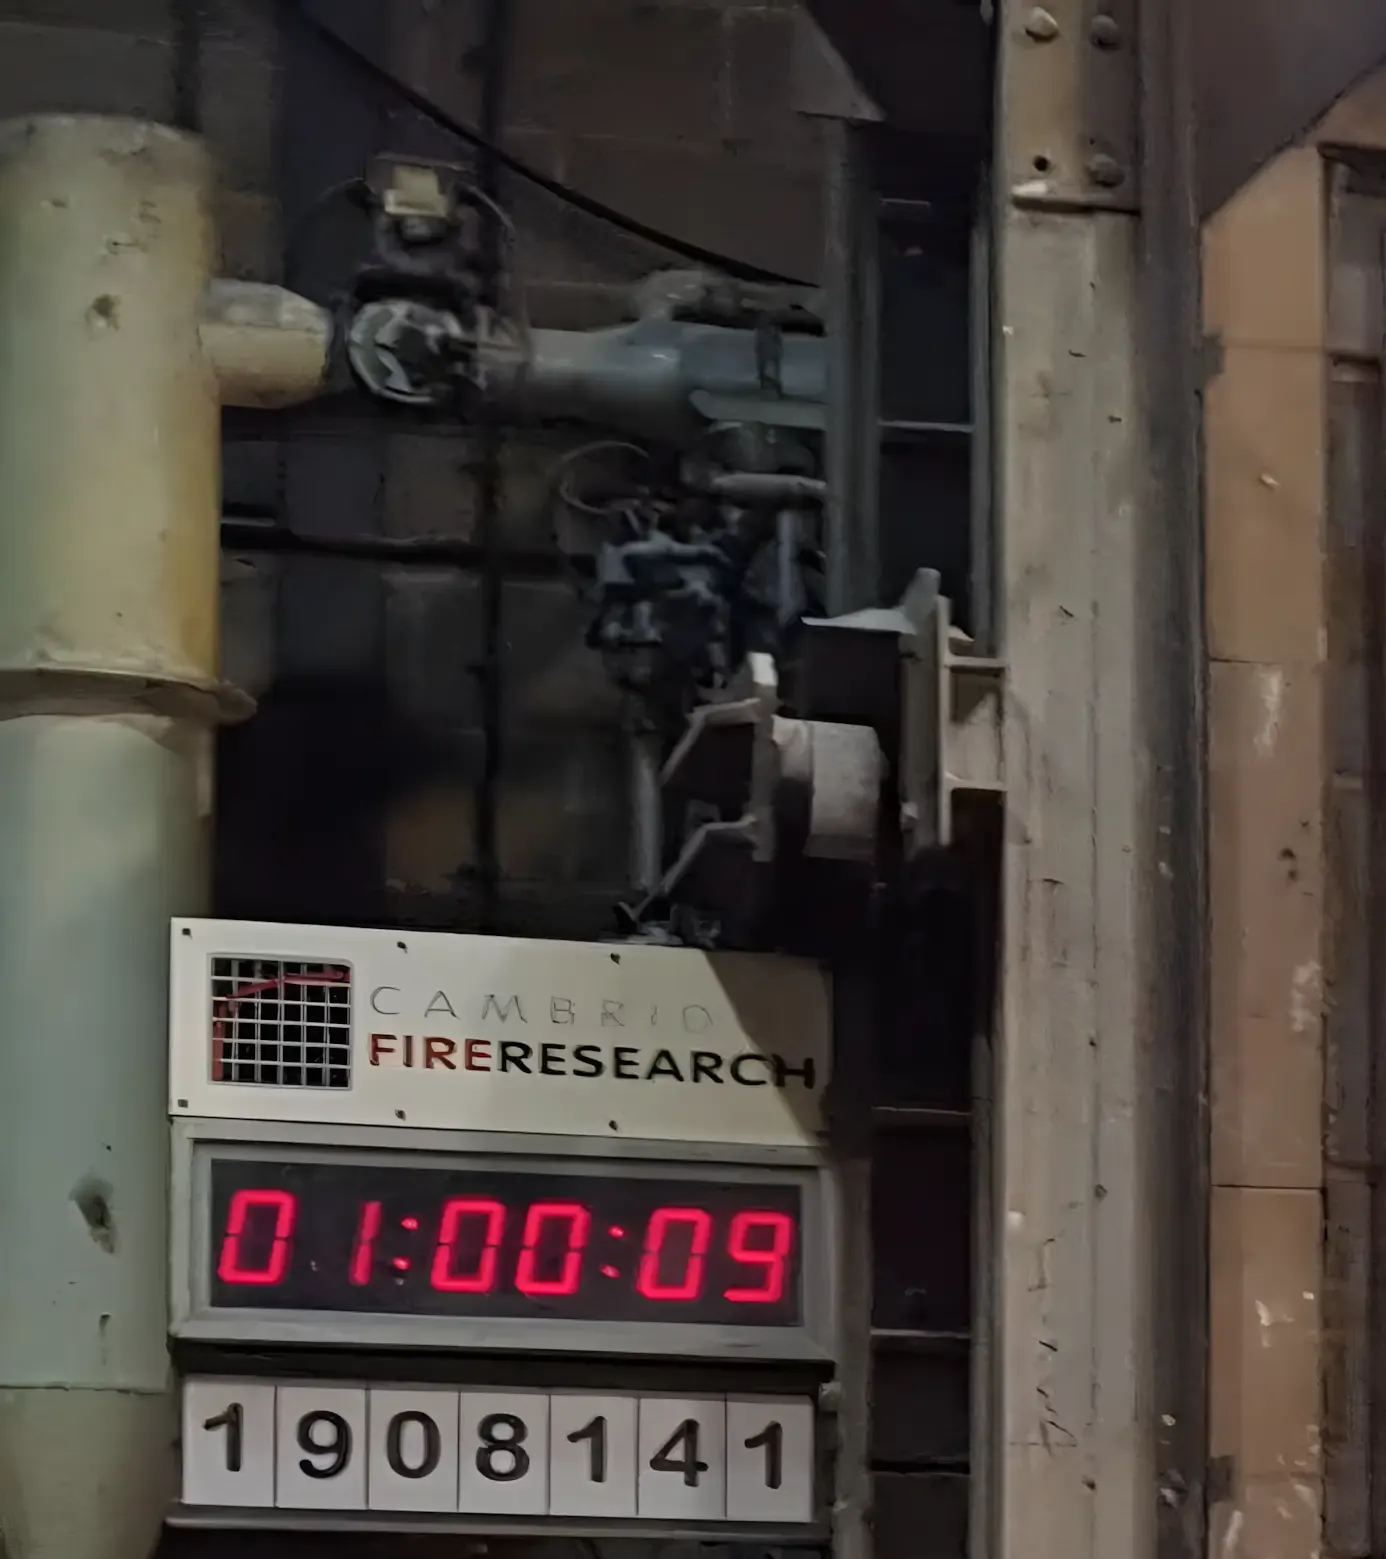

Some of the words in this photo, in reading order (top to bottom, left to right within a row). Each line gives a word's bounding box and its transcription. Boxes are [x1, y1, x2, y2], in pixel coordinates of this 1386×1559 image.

[368, 1033, 816, 1090] FIRERESEARCH
[217, 1188, 794, 1303] 01:00:09
[203, 1401, 783, 1490] 1908141
